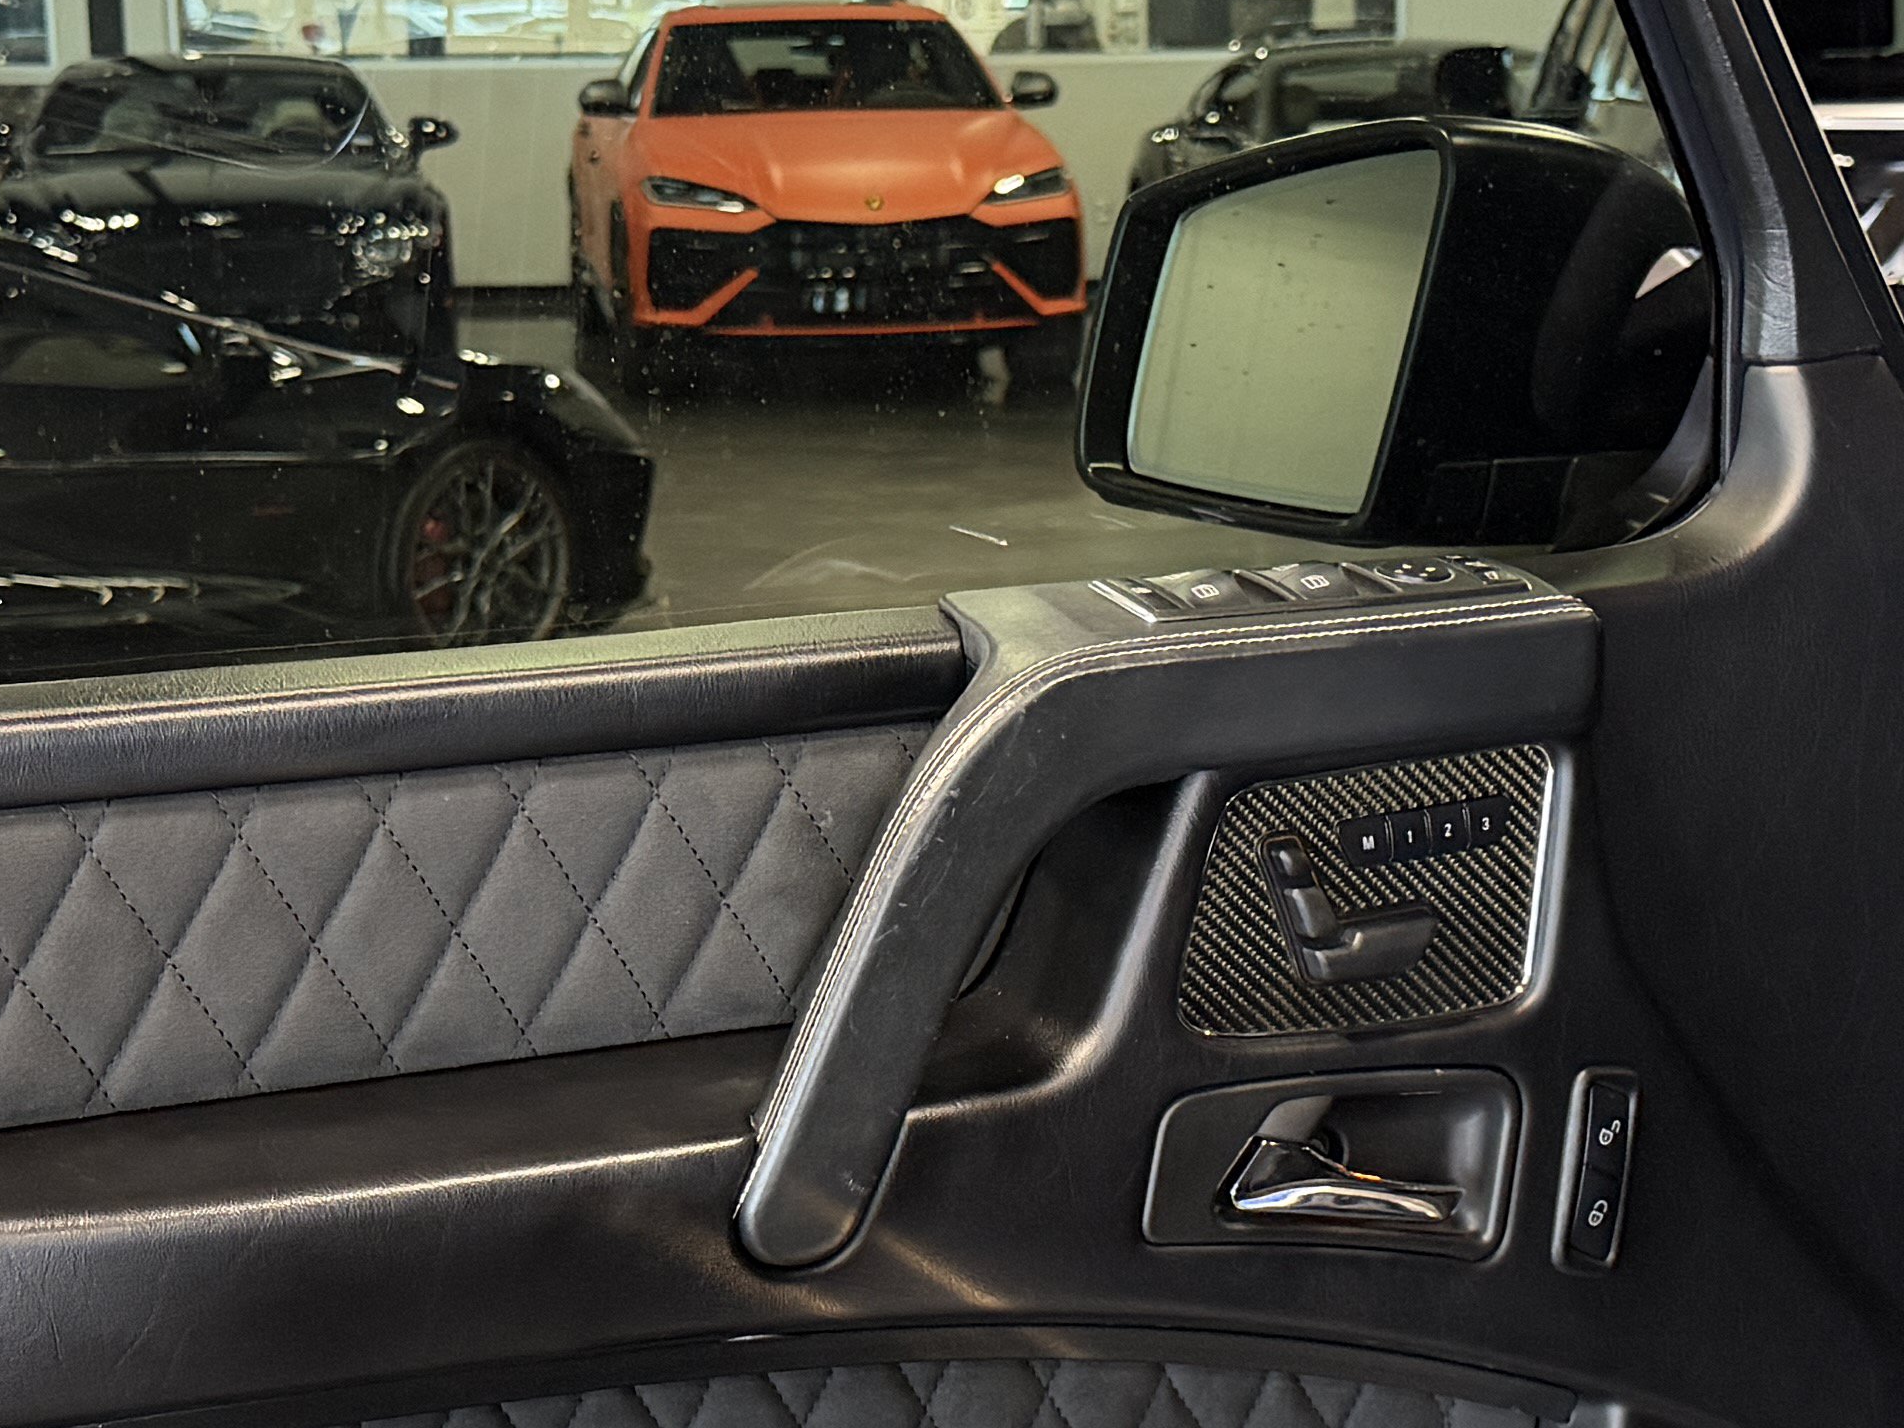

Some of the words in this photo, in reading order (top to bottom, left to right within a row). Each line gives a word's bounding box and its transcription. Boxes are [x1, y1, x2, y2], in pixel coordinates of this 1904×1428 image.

[1444, 822, 1453, 838] 2
[1480, 816, 1491, 831] 3
[1362, 835, 1376, 851] M
[1406, 829, 1414, 844] 1
